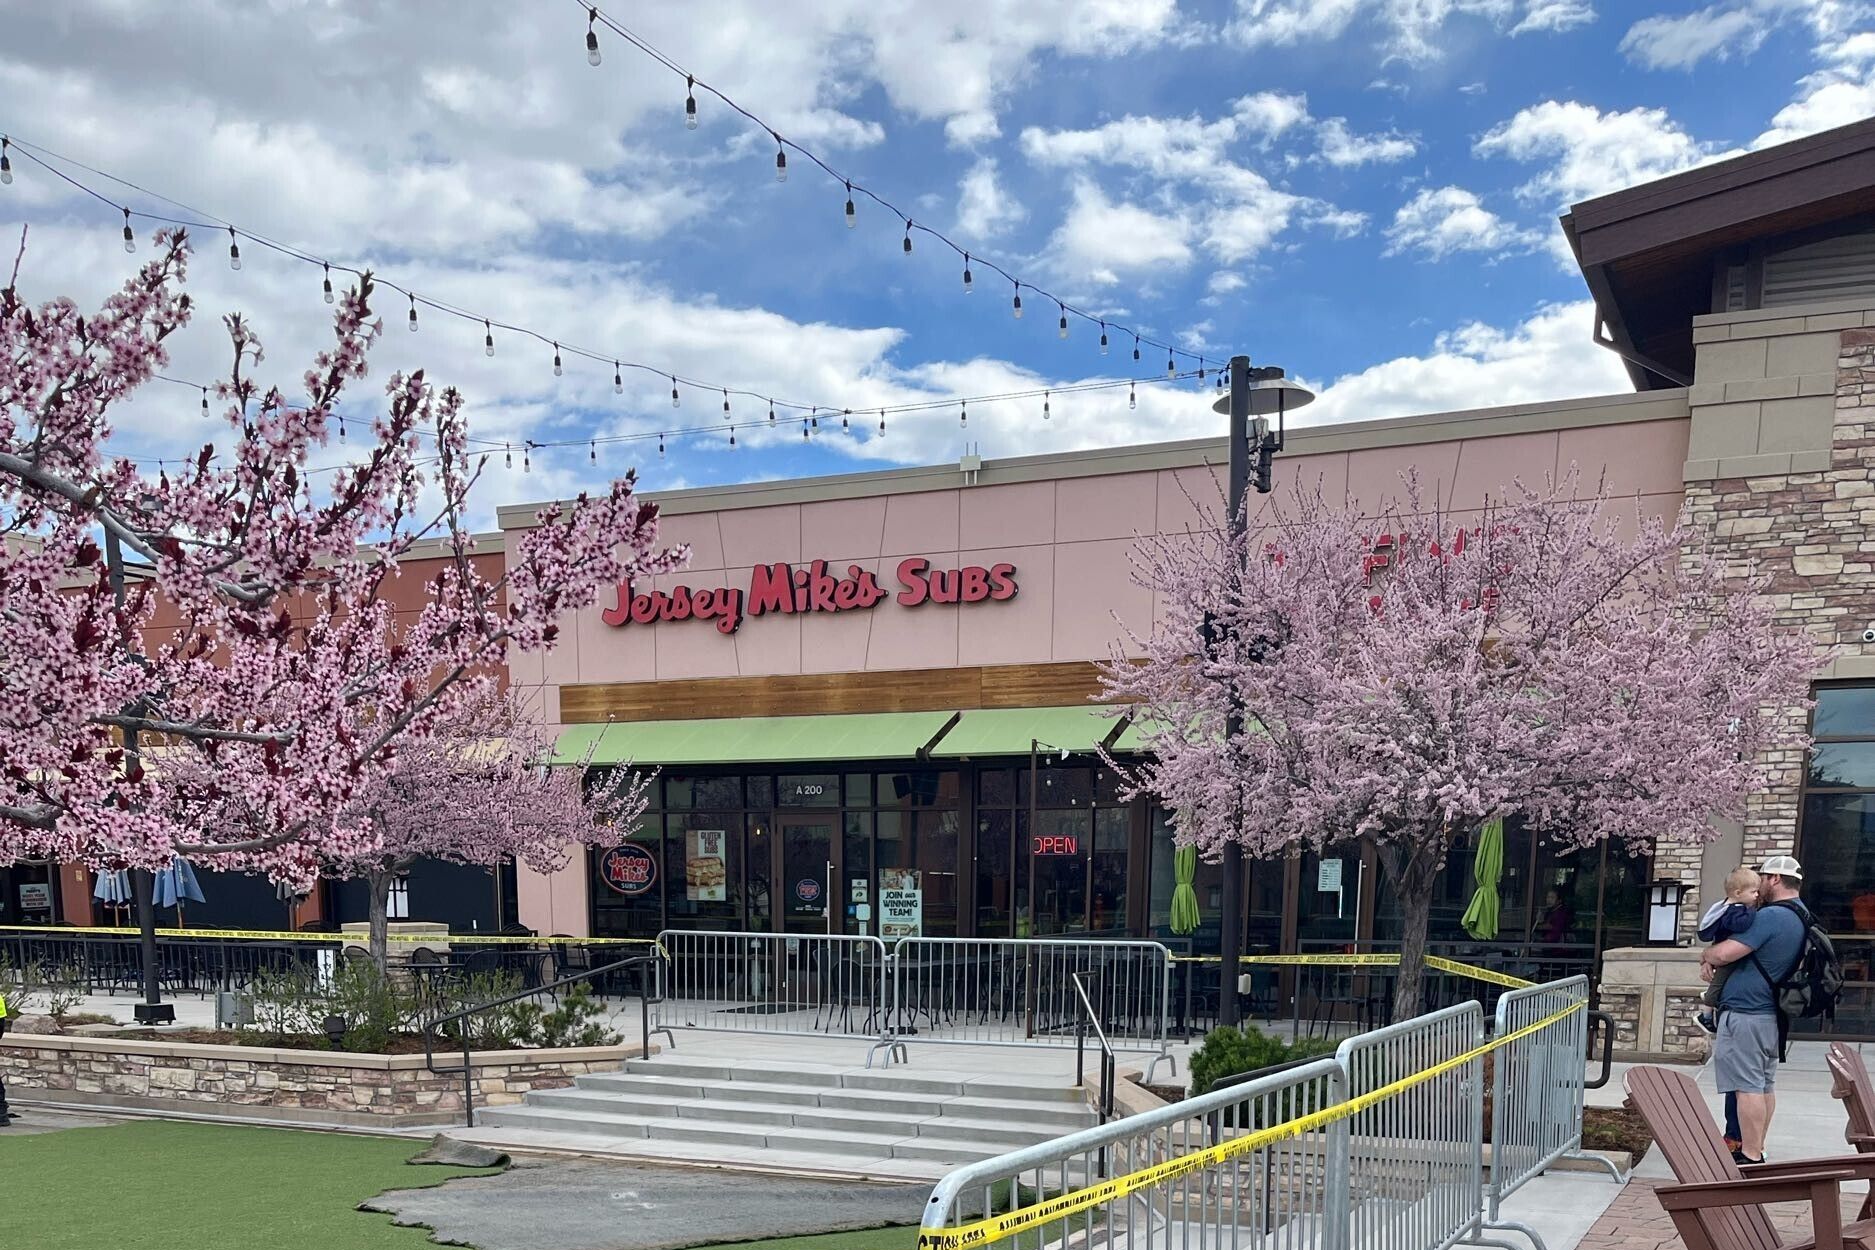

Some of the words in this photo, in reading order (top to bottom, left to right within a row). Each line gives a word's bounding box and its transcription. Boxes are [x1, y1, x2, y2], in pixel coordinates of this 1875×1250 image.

[602, 576, 742, 634] Jersey
[747, 559, 887, 615] Mike's
[796, 785, 803, 795] A
[804, 785, 823, 795] 200
[1034, 837, 1076, 854] OPEN
[608, 852, 649, 872] Jersey
[611, 866, 649, 882] Mike's
[885, 891, 903, 899] JOIN
[882, 900, 918, 908] WINNING
[888, 908, 912, 916] TEAM!
